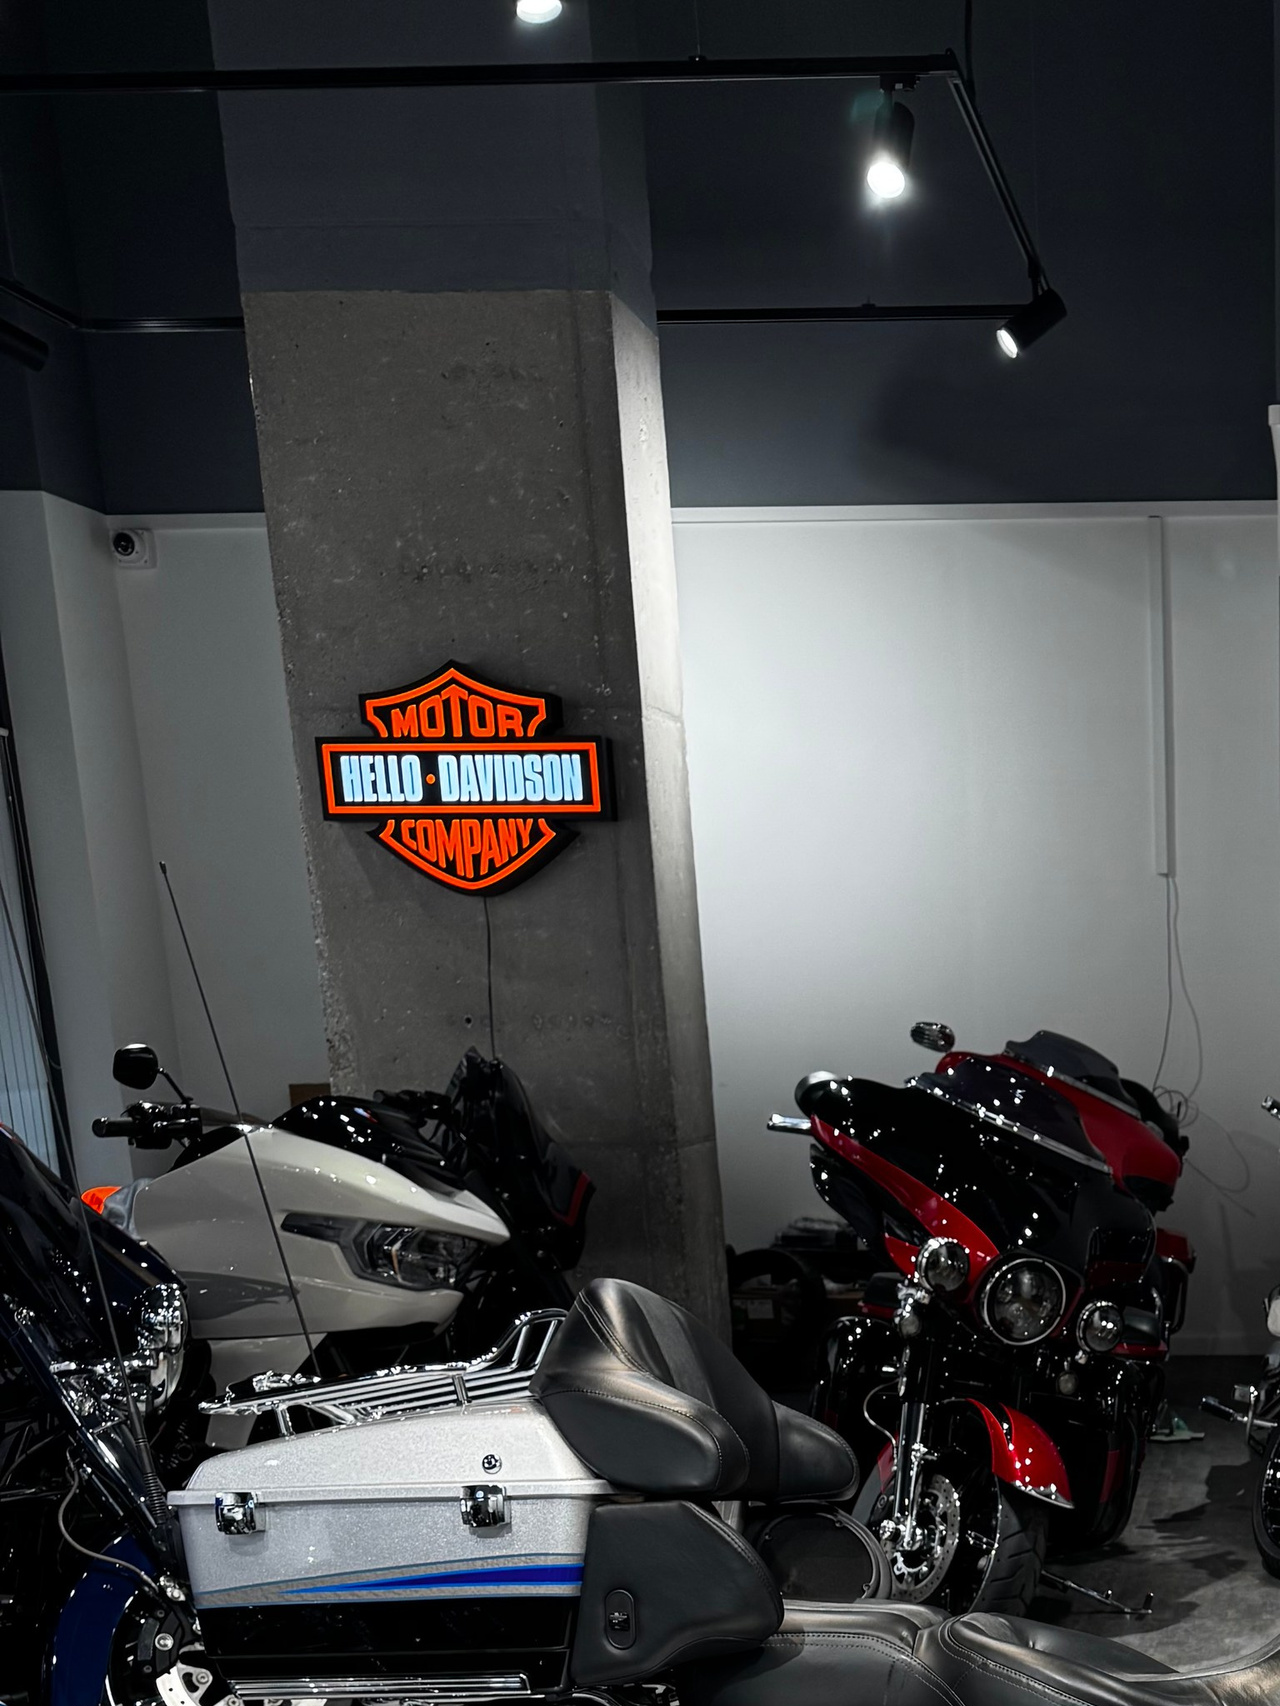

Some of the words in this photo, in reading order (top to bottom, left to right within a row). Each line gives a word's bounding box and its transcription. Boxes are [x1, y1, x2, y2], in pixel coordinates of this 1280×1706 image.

[391, 684, 523, 737] MOTOR
[340, 755, 423, 802] HELLO
[437, 754, 583, 802] DAVIDSON
[400, 818, 533, 878] COMPANY
